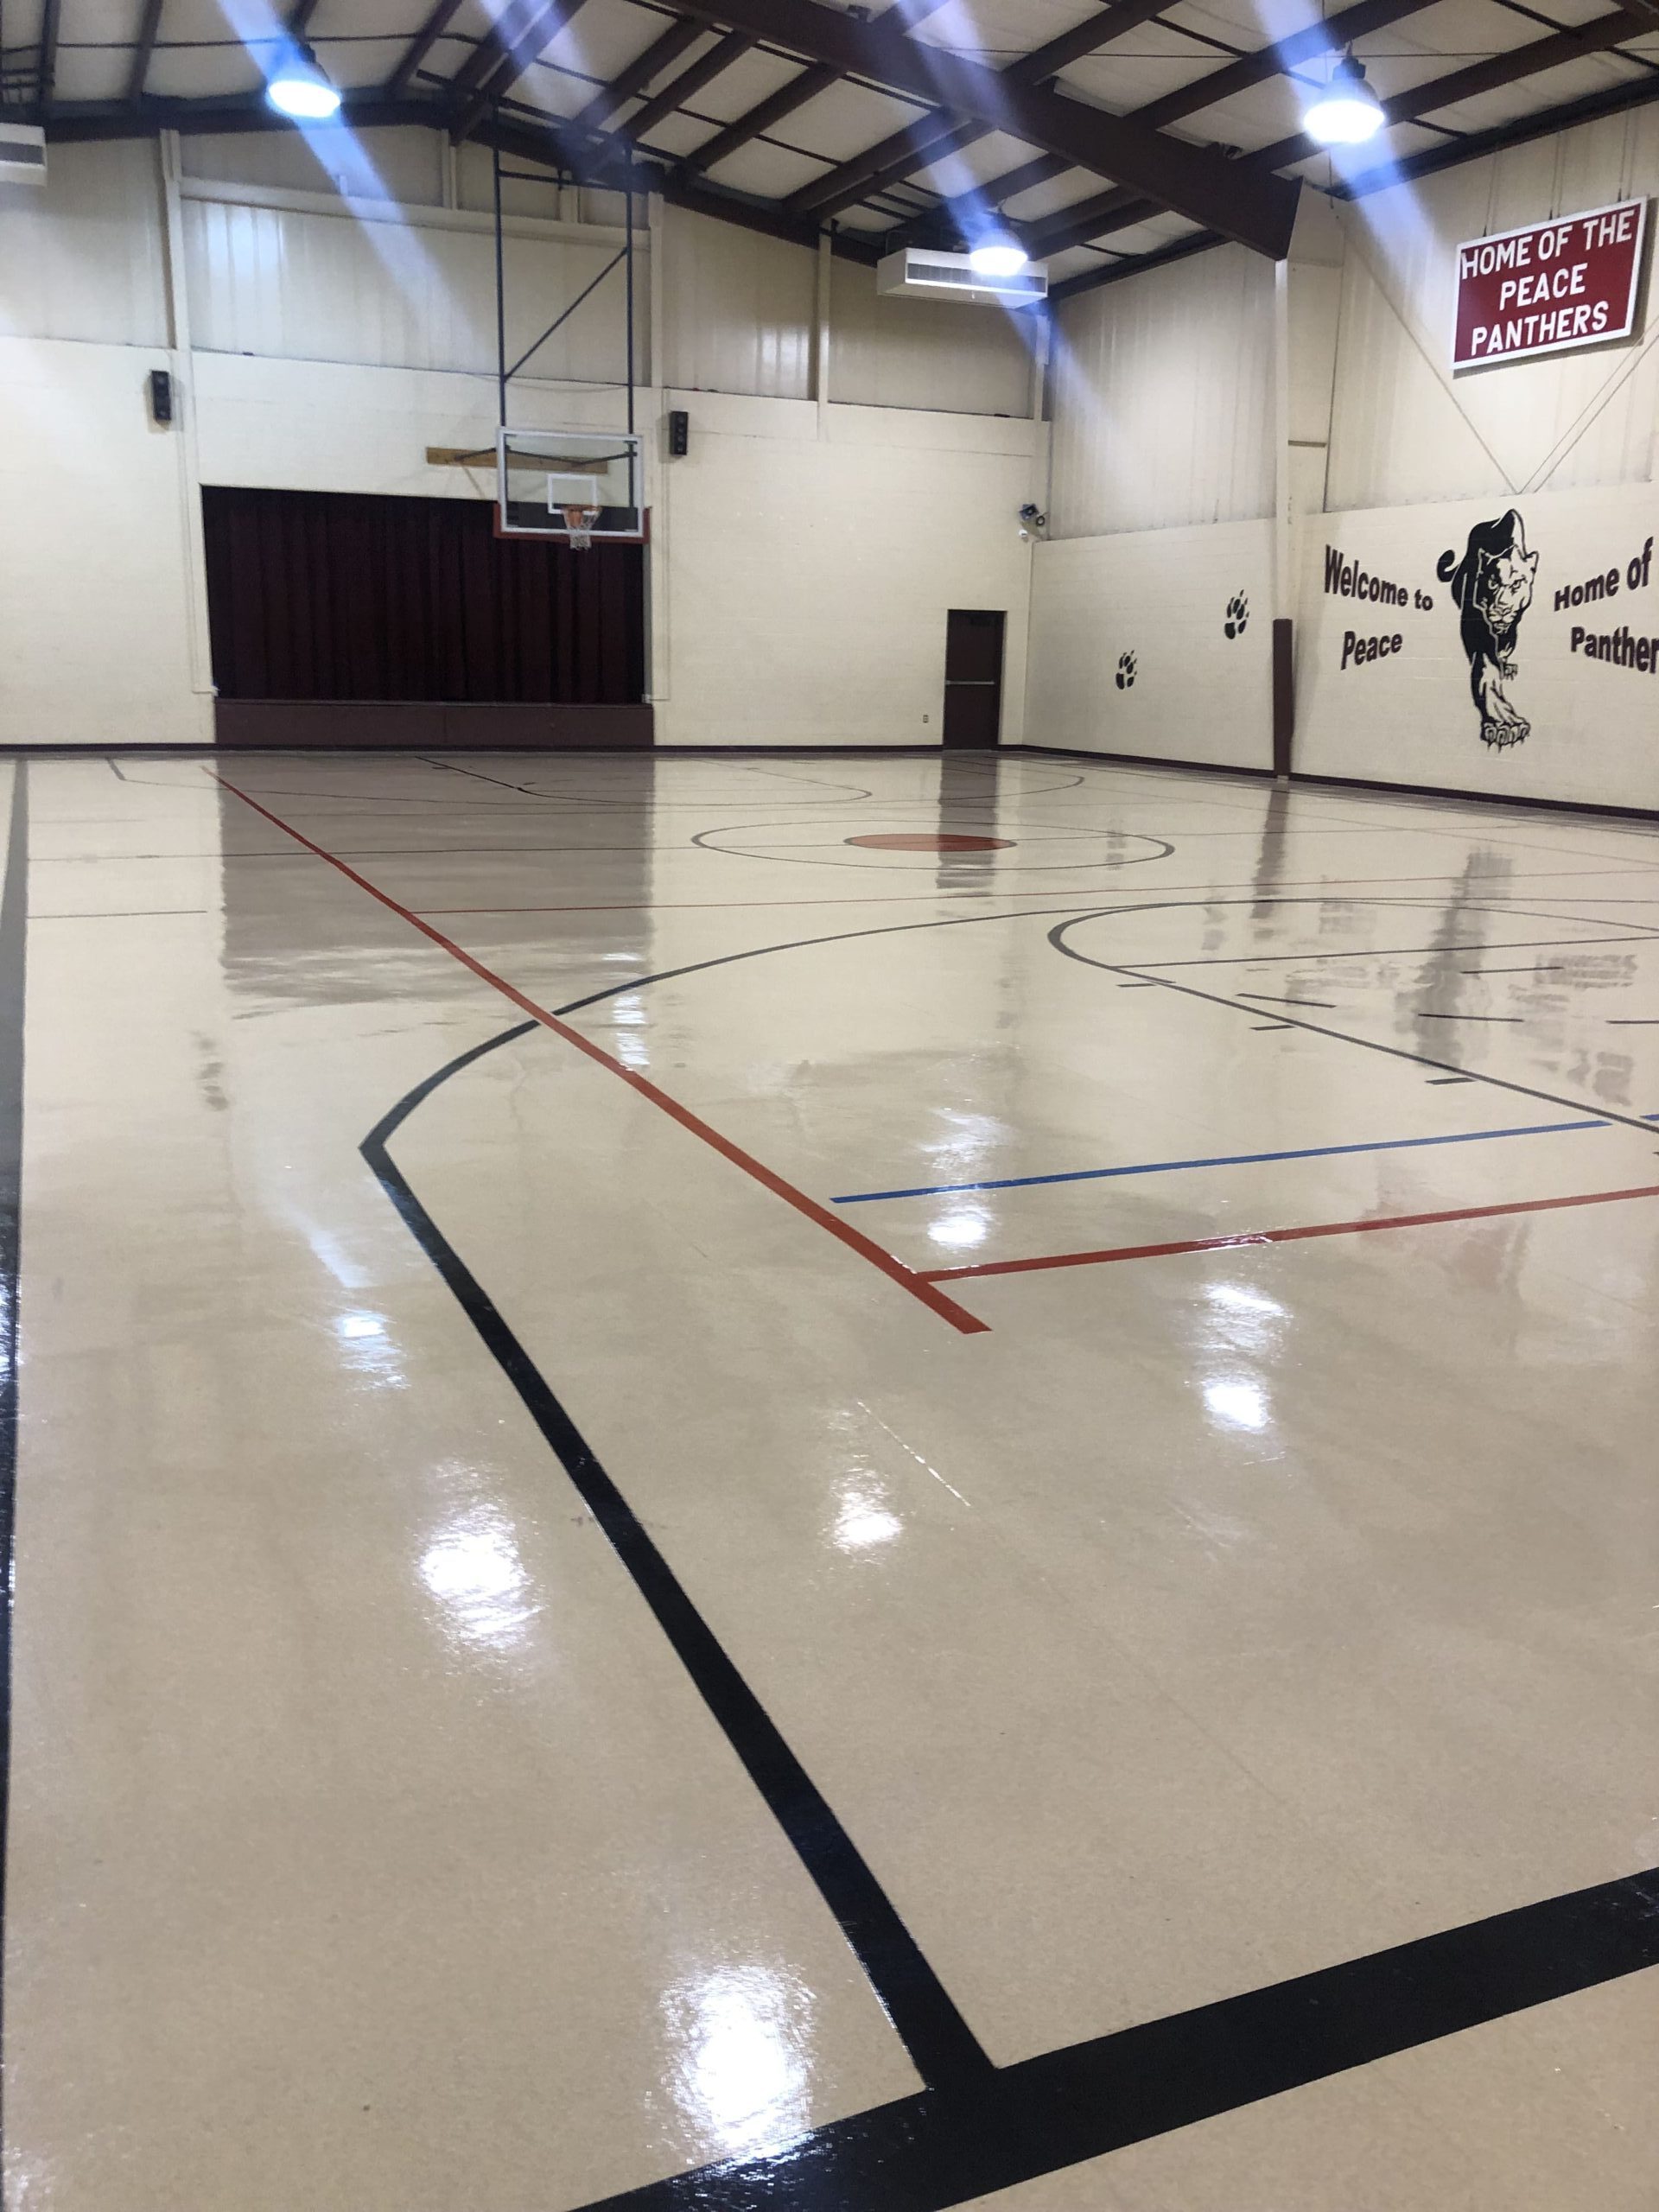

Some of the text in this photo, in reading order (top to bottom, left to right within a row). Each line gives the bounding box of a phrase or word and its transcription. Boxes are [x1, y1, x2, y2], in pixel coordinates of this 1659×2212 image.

[1462, 209, 1635, 280] HOME OF THE
[1499, 263, 1588, 311] PEACE
[1471, 300, 1609, 356] PANTHERS
[1324, 543, 1433, 611] Welcome to
[1554, 535, 1654, 612] Home of
[1340, 631, 1403, 671] Peace
